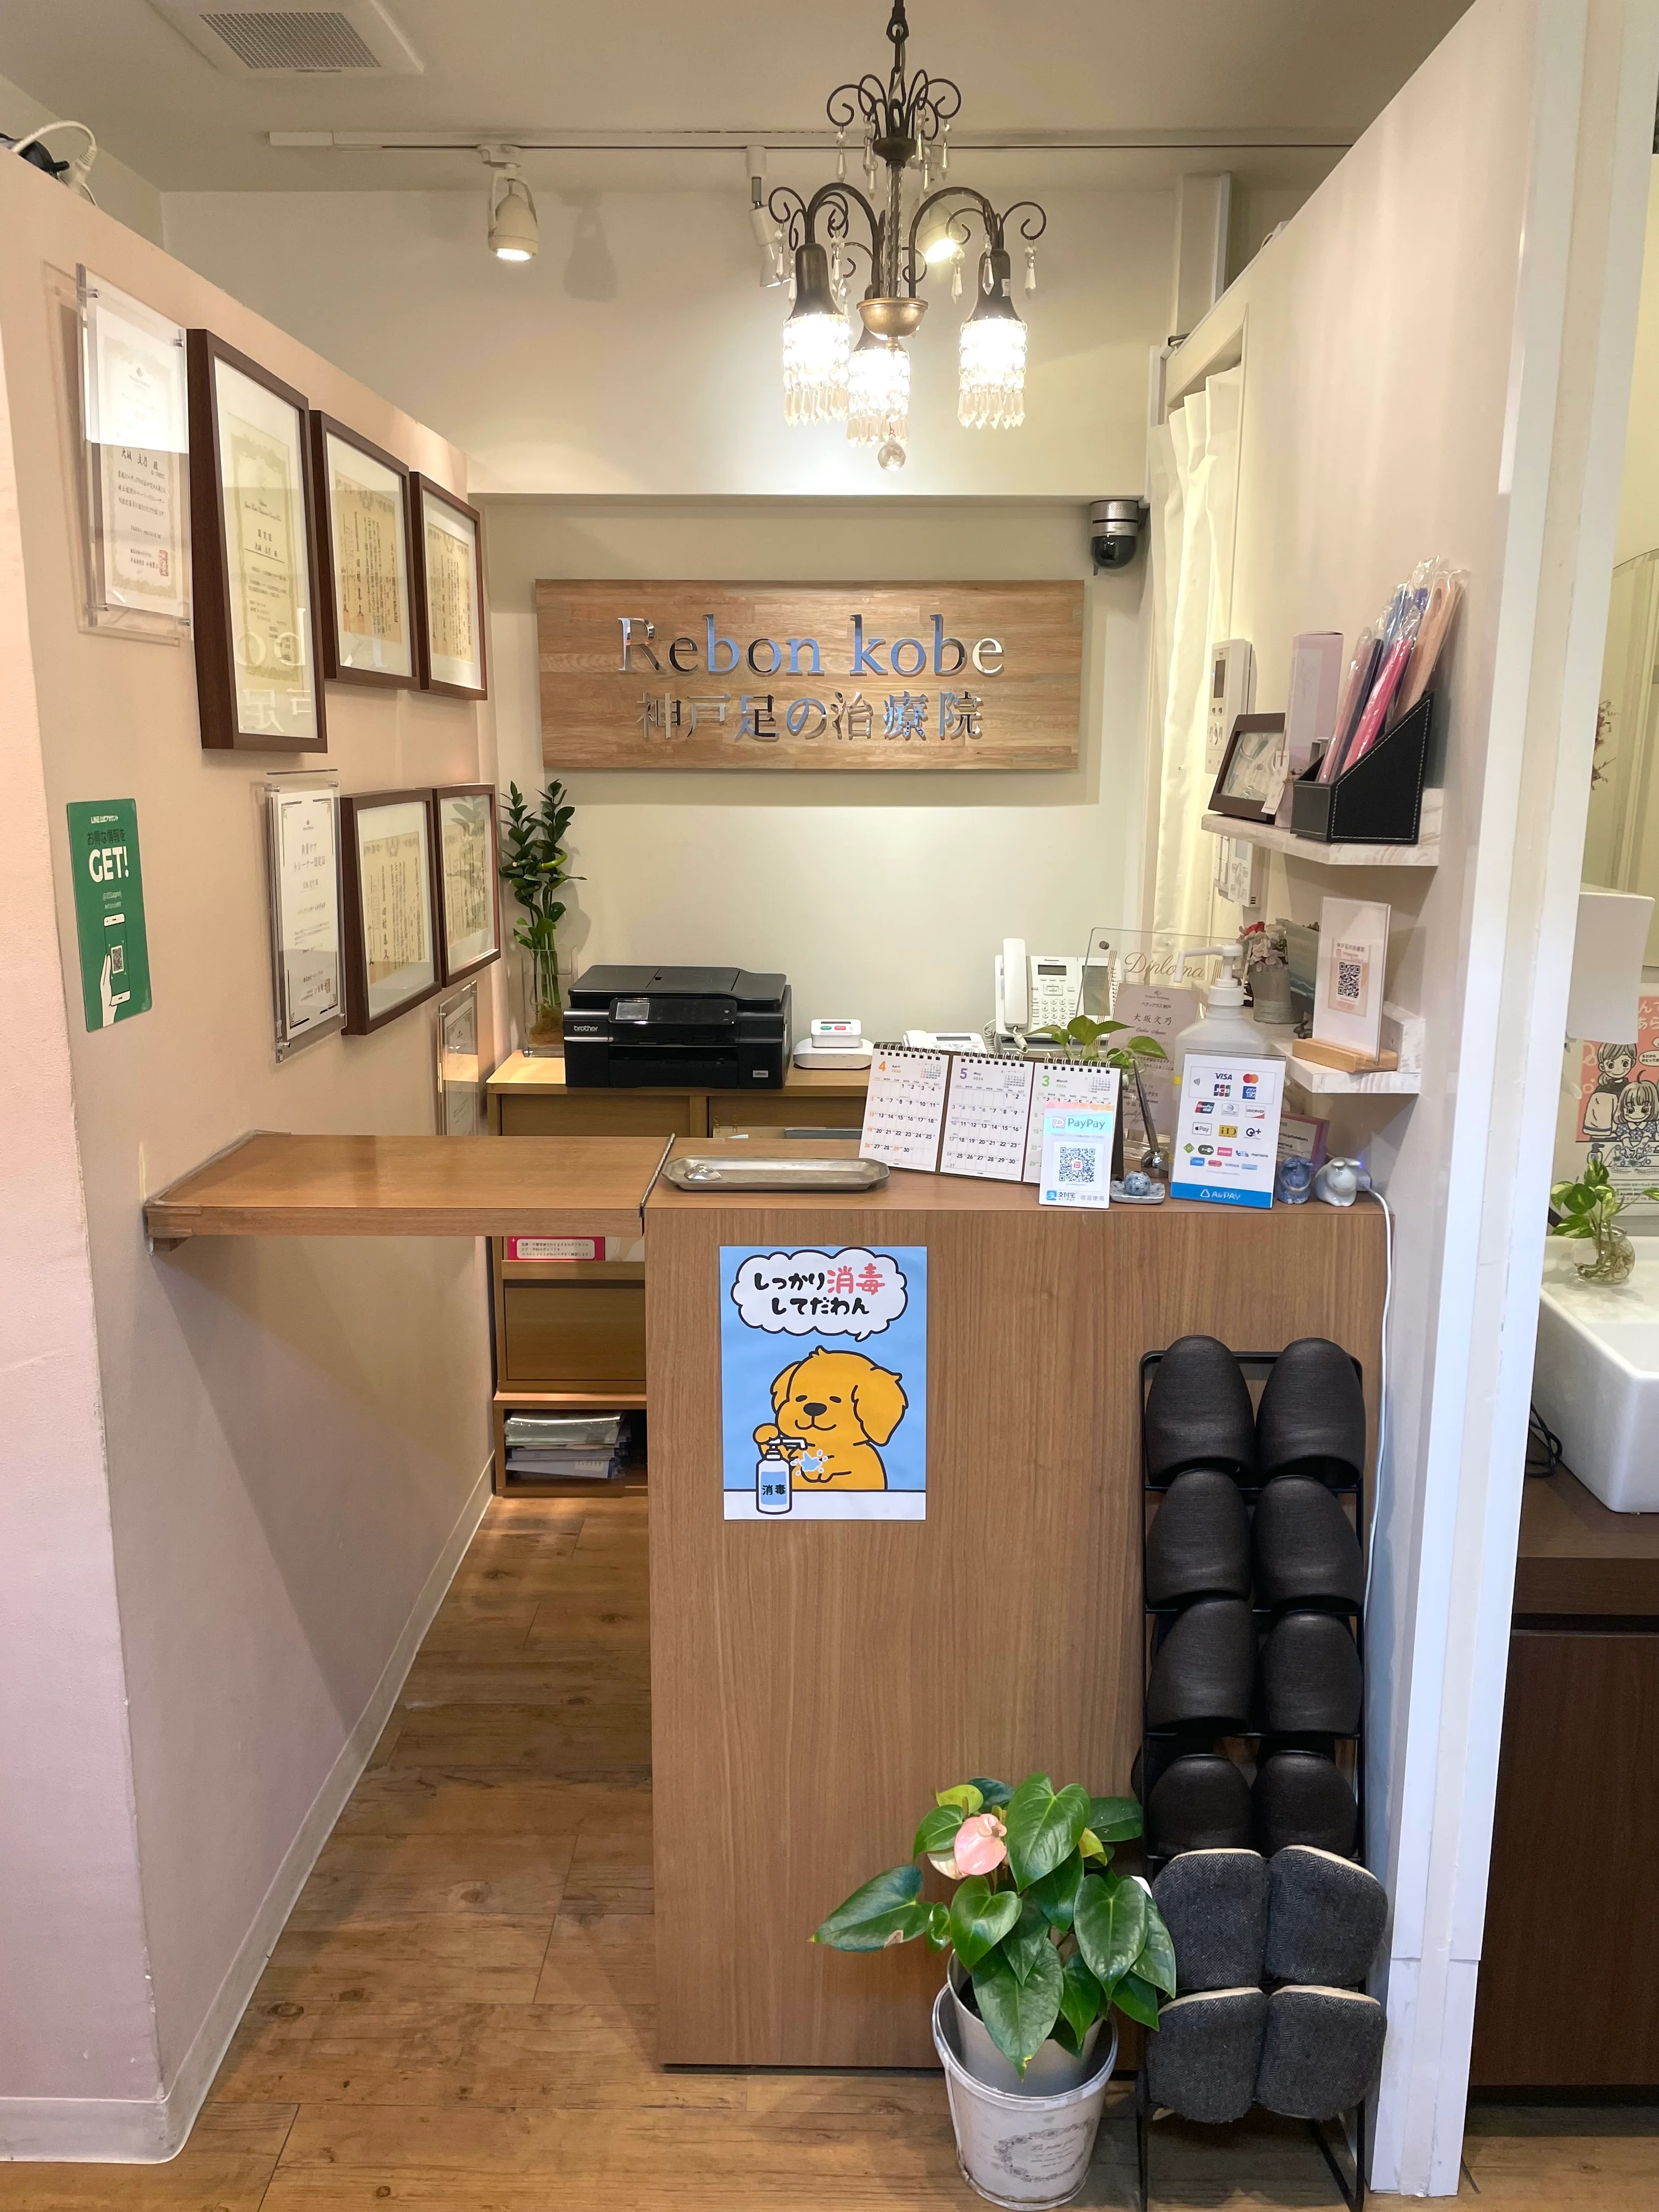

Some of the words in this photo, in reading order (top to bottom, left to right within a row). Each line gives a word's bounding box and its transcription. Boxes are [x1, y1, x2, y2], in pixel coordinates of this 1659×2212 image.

[617, 614, 825, 675] Rebon
[849, 614, 1005, 677] kobe
[636, 690, 984, 741] 神戸足の治療院
[89, 846, 129, 883] GET!
[879, 1061, 886, 1071] 4
[960, 1068, 967, 1079] 5
[1042, 1075, 1049, 1086] 3
[1068, 1118, 1105, 1130] PayPay
[1221, 1127, 1237, 1136] iD
[754, 1263, 885, 1295] しっかり消毒
[771, 1297, 870, 1315] してだわん
[761, 1484, 786, 1496] 消毒
